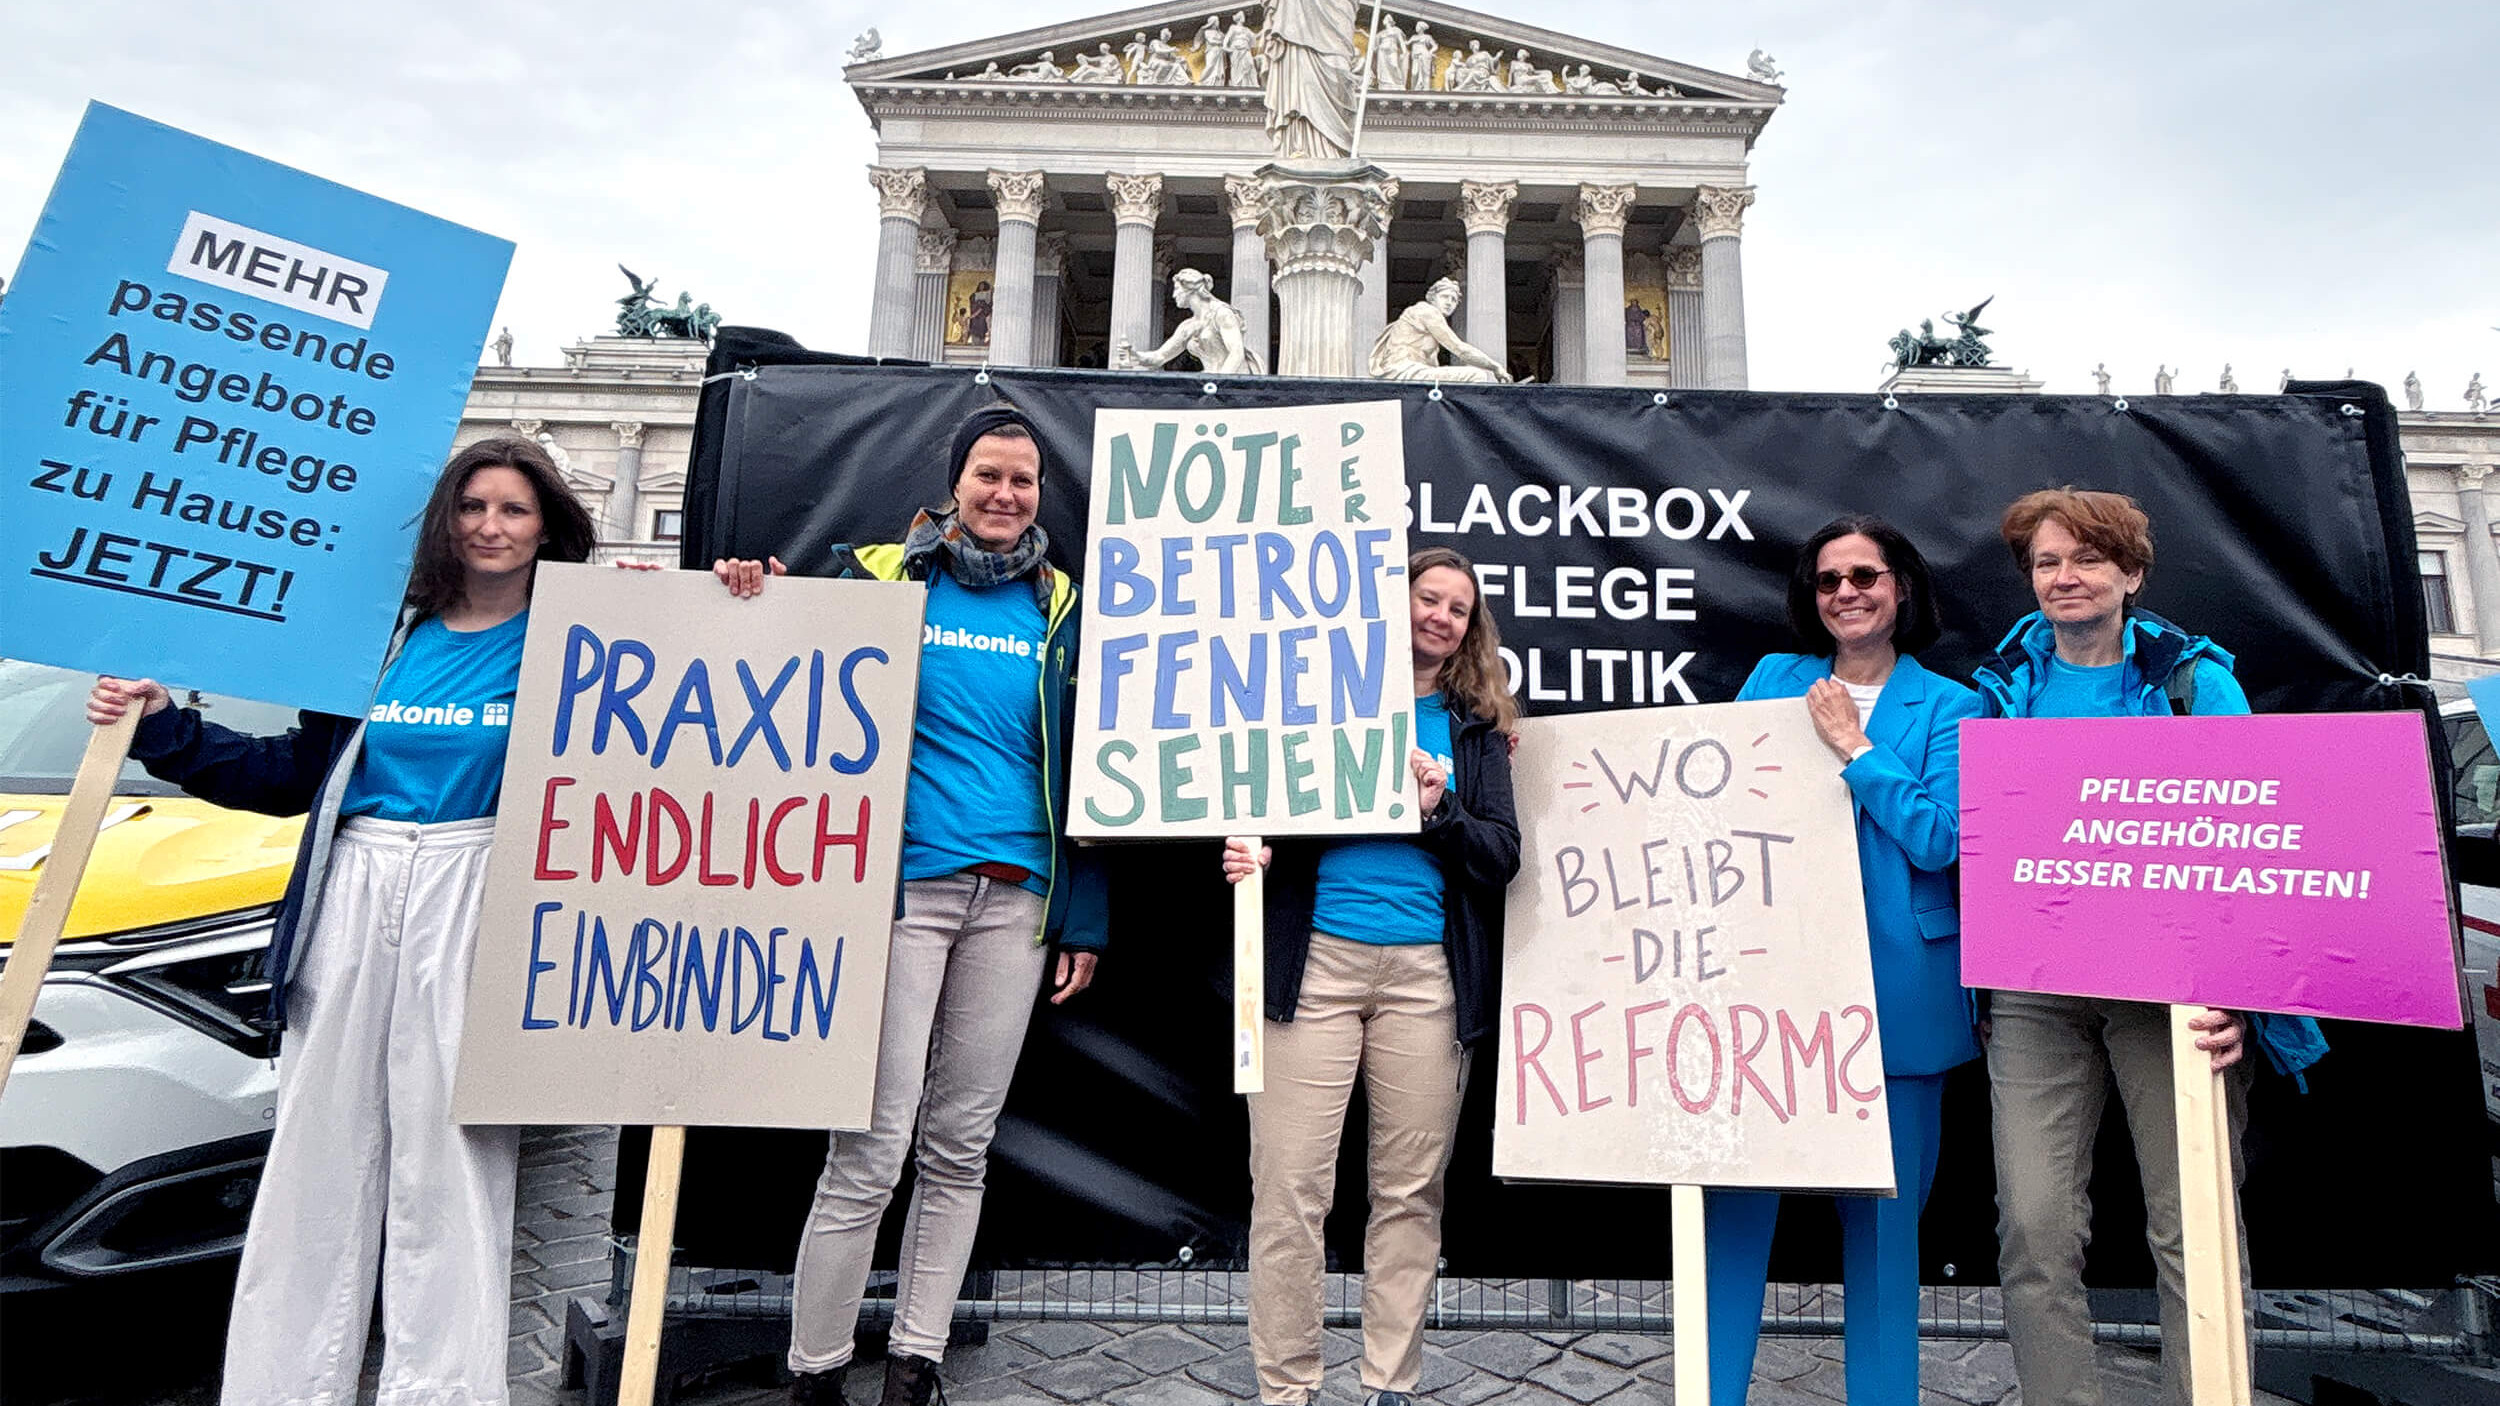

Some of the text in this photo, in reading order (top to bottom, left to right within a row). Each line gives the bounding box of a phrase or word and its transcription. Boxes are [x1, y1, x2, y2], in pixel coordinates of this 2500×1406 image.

[189, 230, 370, 315] MEHR
[108, 279, 395, 381] passende
[84, 332, 376, 436] Angebote
[65, 390, 358, 493] für Pflege
[1106, 423, 1313, 525] NÖTE
[30, 459, 343, 552] zu Hause:
[1405, 483, 1755, 541] LACKBOX
[35, 527, 295, 615] JETZT!
[1099, 529, 1406, 620] BETROF-
[1472, 563, 1697, 621] FLEGE
[369, 699, 475, 726] akonie
[553, 624, 889, 775] PRAXIS
[1098, 620, 1387, 731] FENEN
[1497, 646, 1699, 704] LITIK
[1084, 711, 1409, 827] SEHEN!
[1592, 739, 1732, 804] WO
[2079, 778, 2281, 806] PFLEGENDE
[534, 777, 871, 890] ENDLICH
[1555, 830, 1795, 918] BLEIBT
[2013, 858, 2371, 900] BESSER ENTLASTEN!
[2062, 816, 2304, 851] ANGEHÖRIGE
[522, 902, 844, 1042] EINBINDEN
[1512, 999, 1882, 1125] REFORM?
